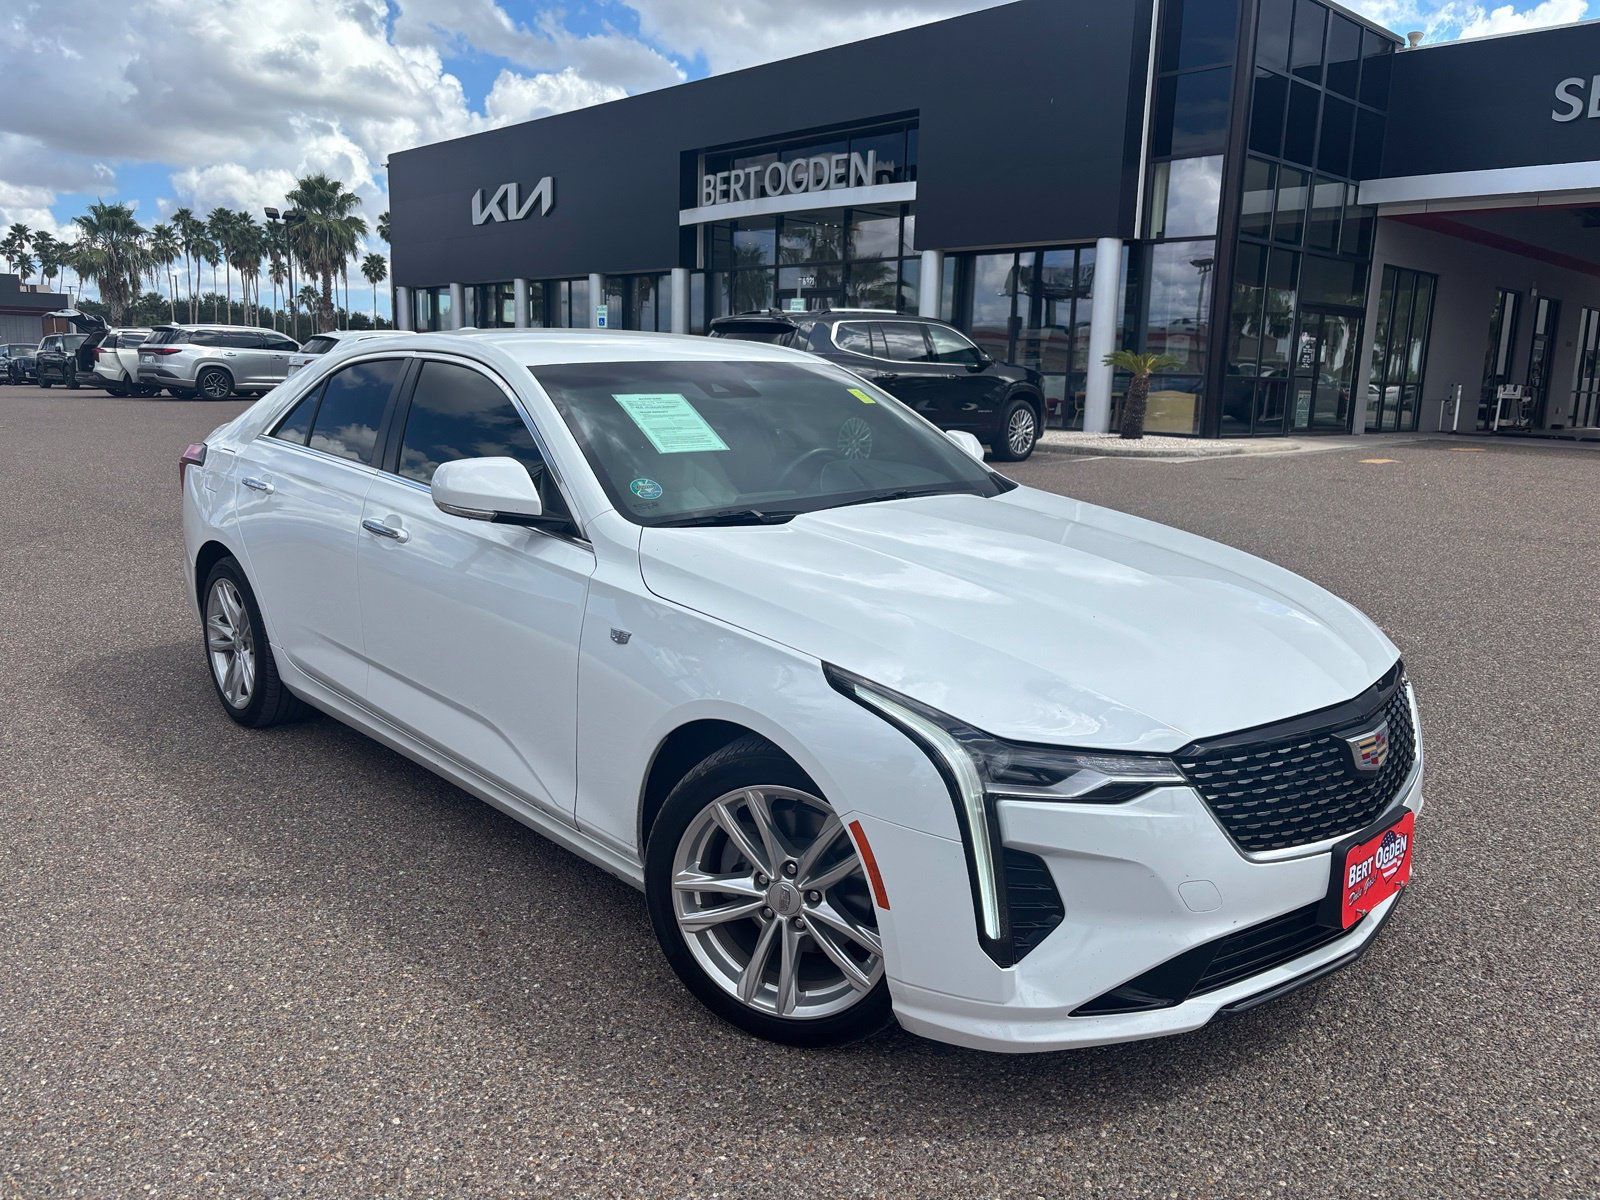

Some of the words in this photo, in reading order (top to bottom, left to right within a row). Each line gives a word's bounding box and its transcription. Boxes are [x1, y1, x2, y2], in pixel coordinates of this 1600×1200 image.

[471, 176, 554, 226] KIA
[703, 165, 762, 207] BERT
[764, 149, 876, 197] OGDEN
[1348, 856, 1374, 888] BERT
[1375, 834, 1408, 869] OGDEN
